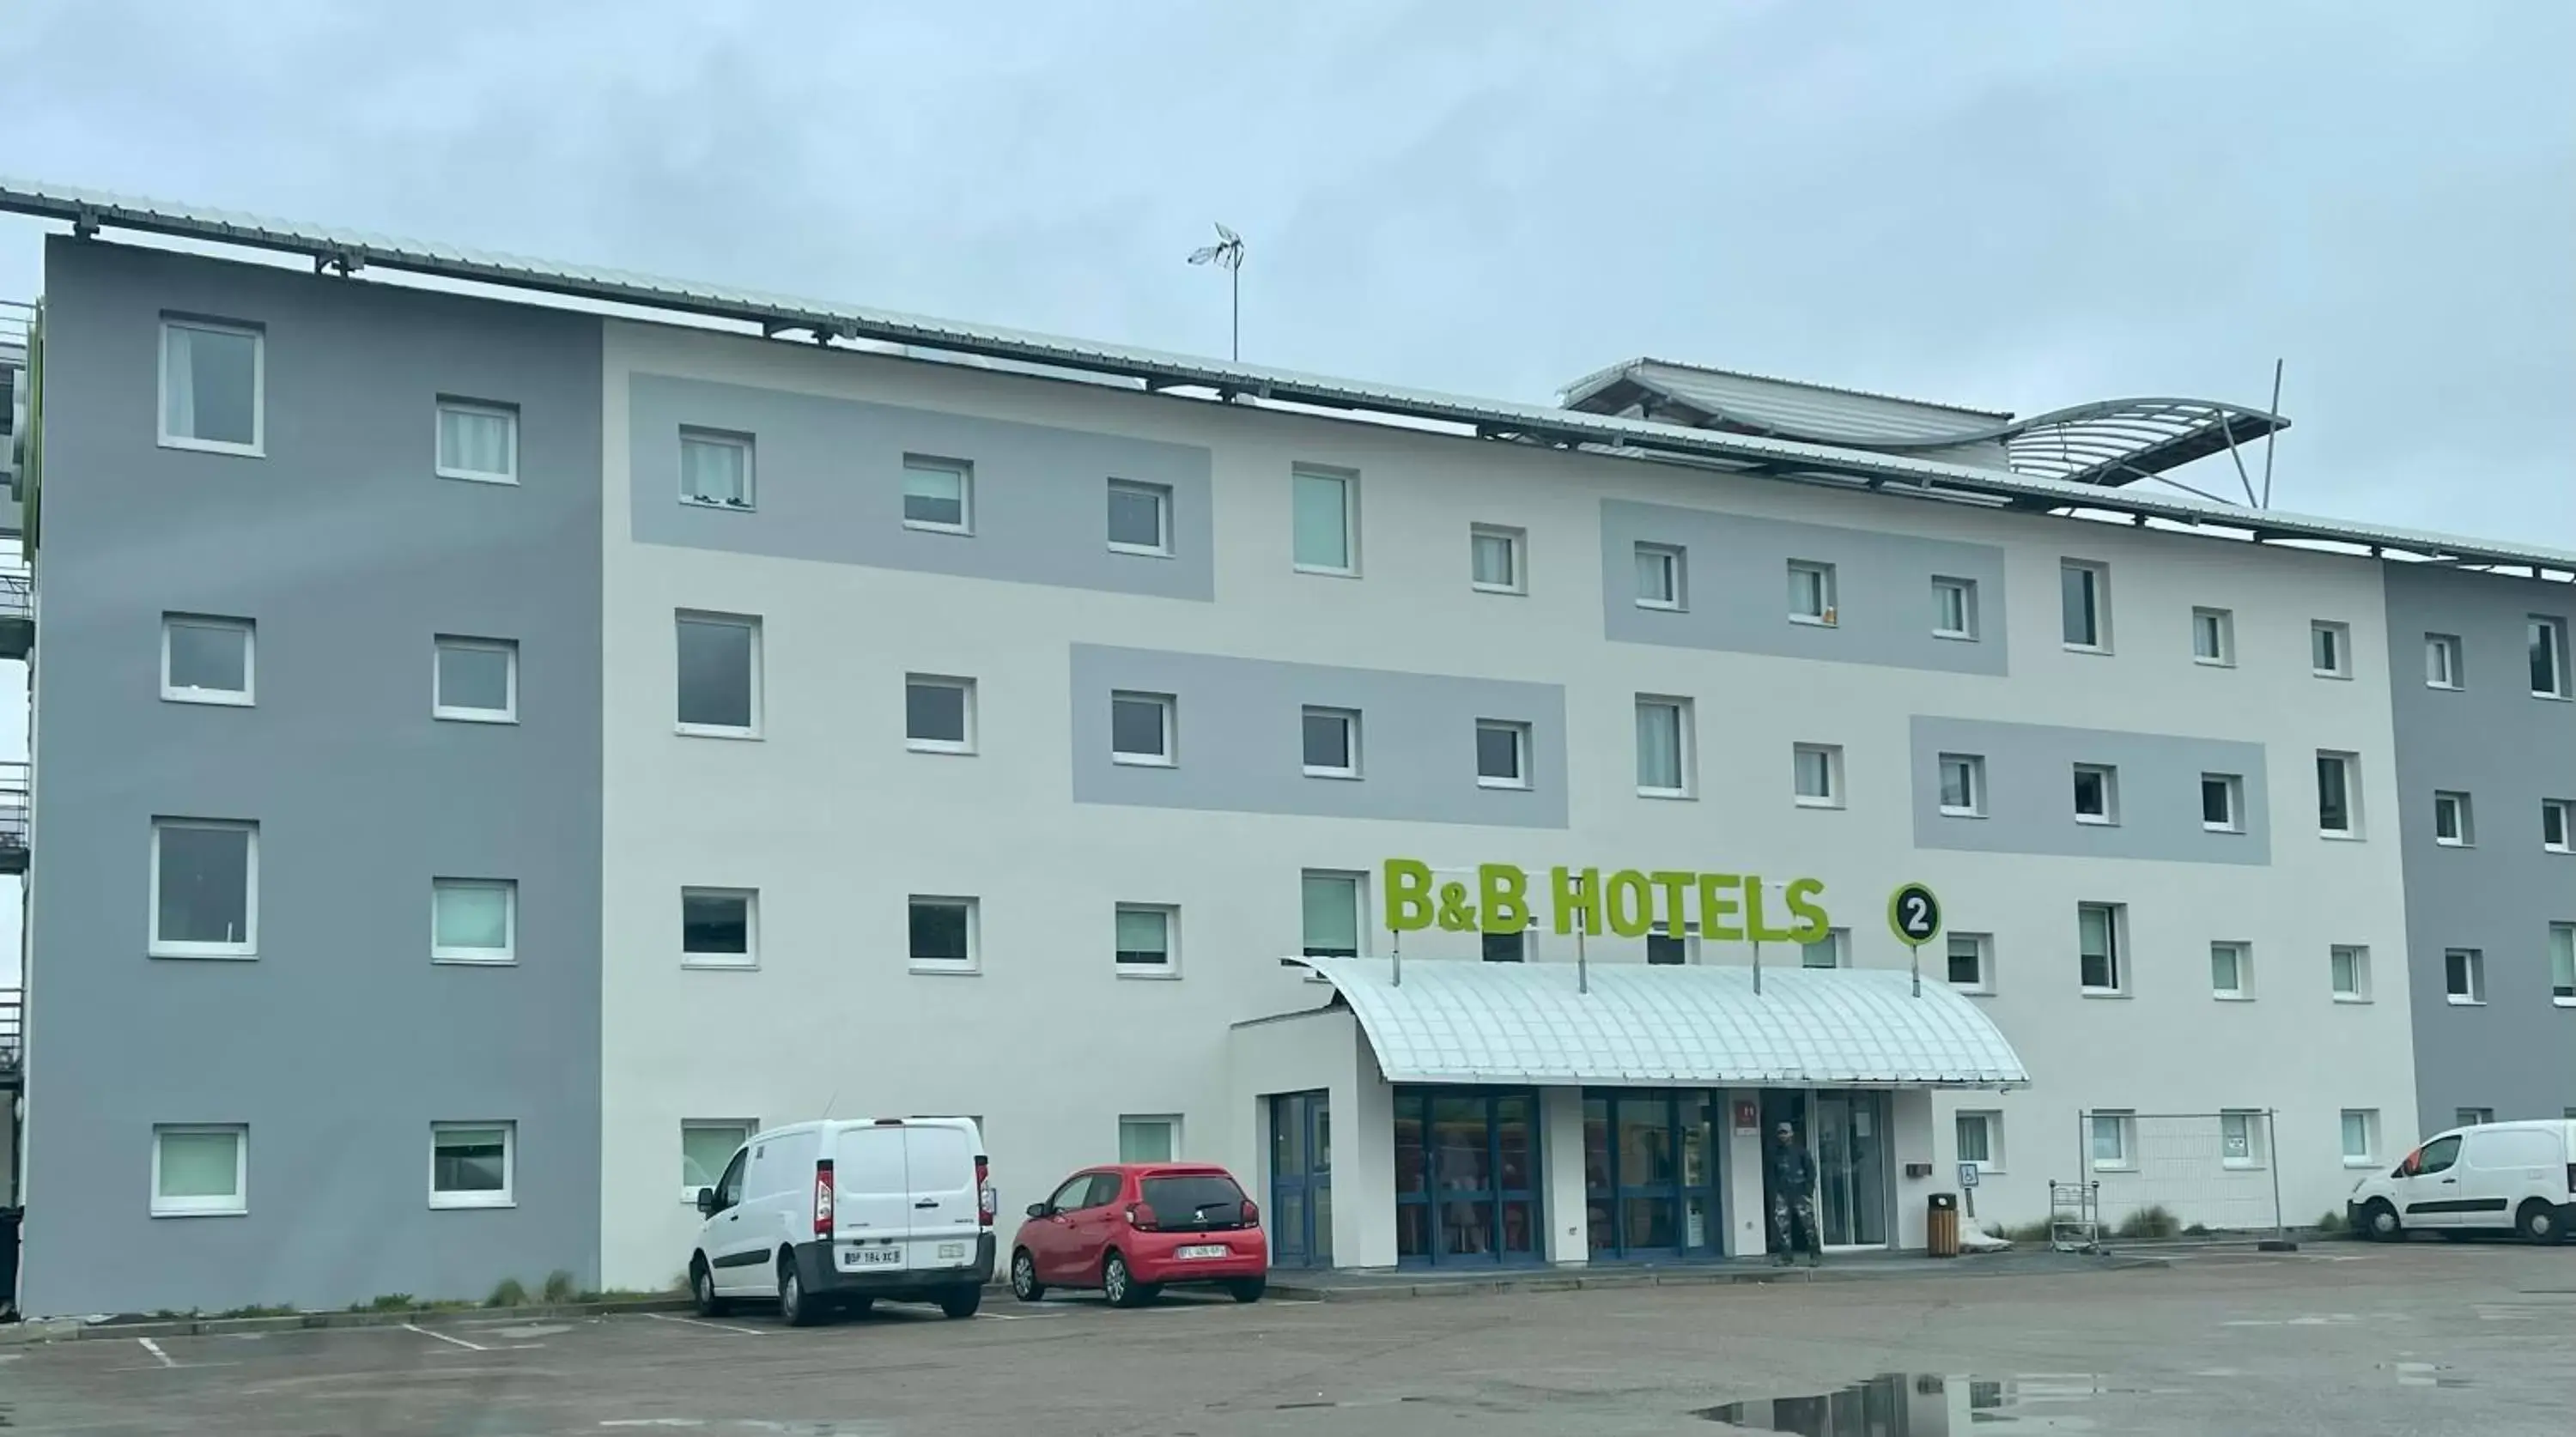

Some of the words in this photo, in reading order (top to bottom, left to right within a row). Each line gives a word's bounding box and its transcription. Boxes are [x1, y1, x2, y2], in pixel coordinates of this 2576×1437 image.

[1384, 859, 1529, 934] B&B
[1552, 866, 1829, 943] HOTELS
[1907, 897, 1929, 931] 2
